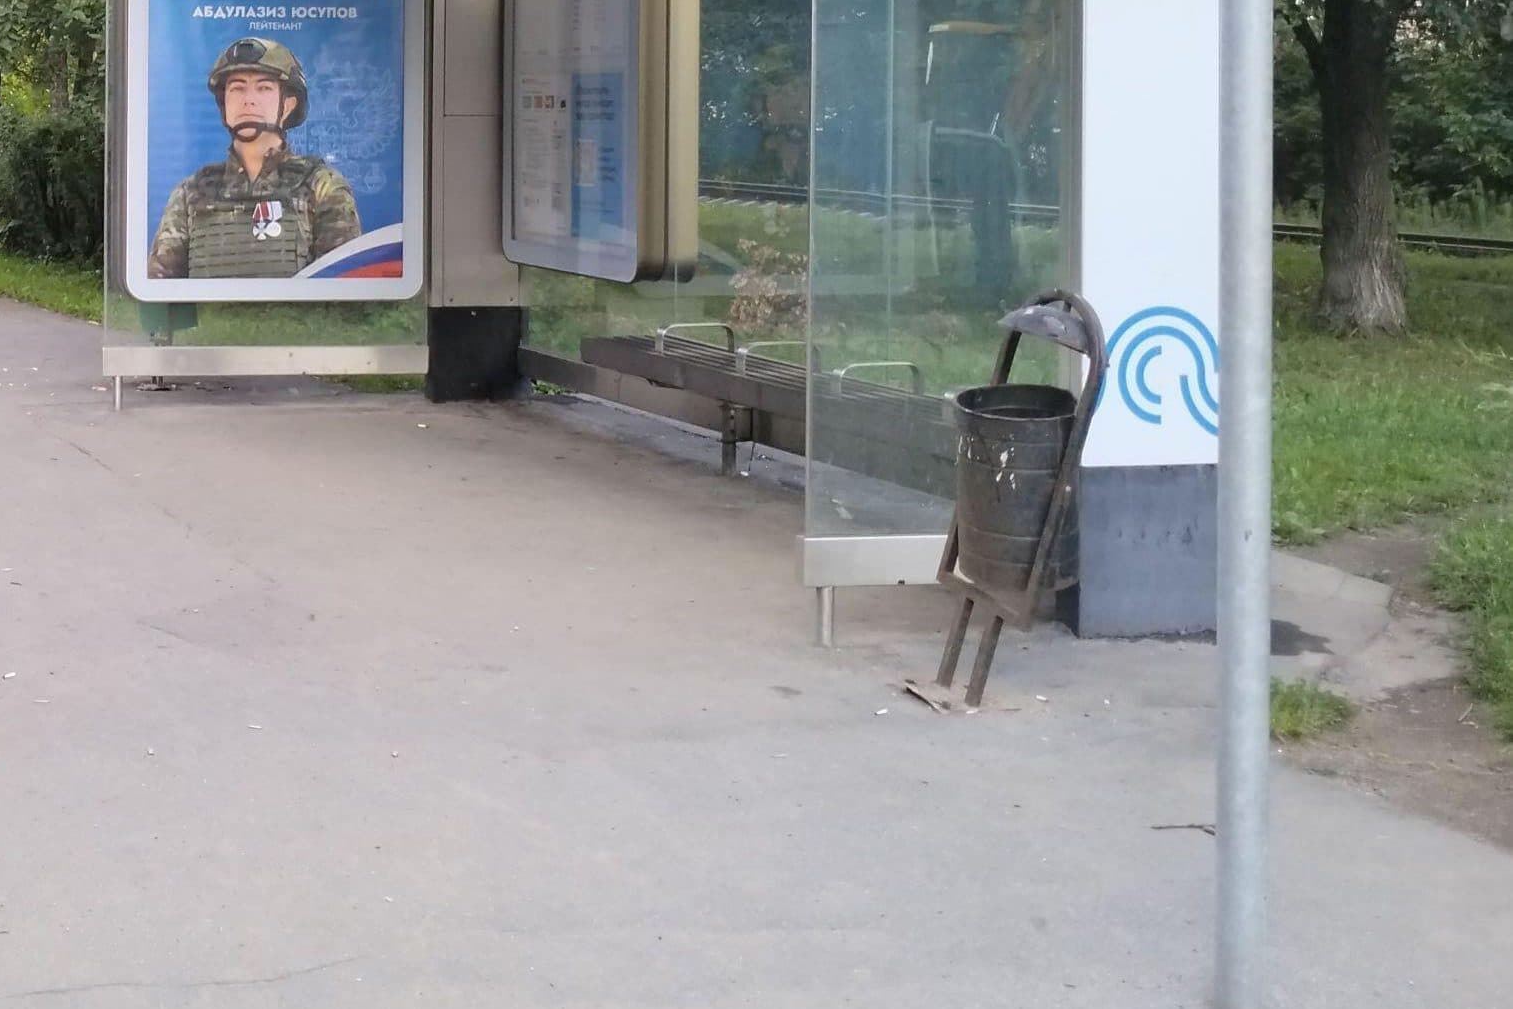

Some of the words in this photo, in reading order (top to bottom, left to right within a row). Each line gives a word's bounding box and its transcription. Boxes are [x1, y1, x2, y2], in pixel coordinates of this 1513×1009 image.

[192, 4, 287, 20] АБДУЛАЗИЗ
[291, 5, 358, 20] ЮСУПОВ
[248, 21, 303, 31] ЛЕЙТЕНАНТ
